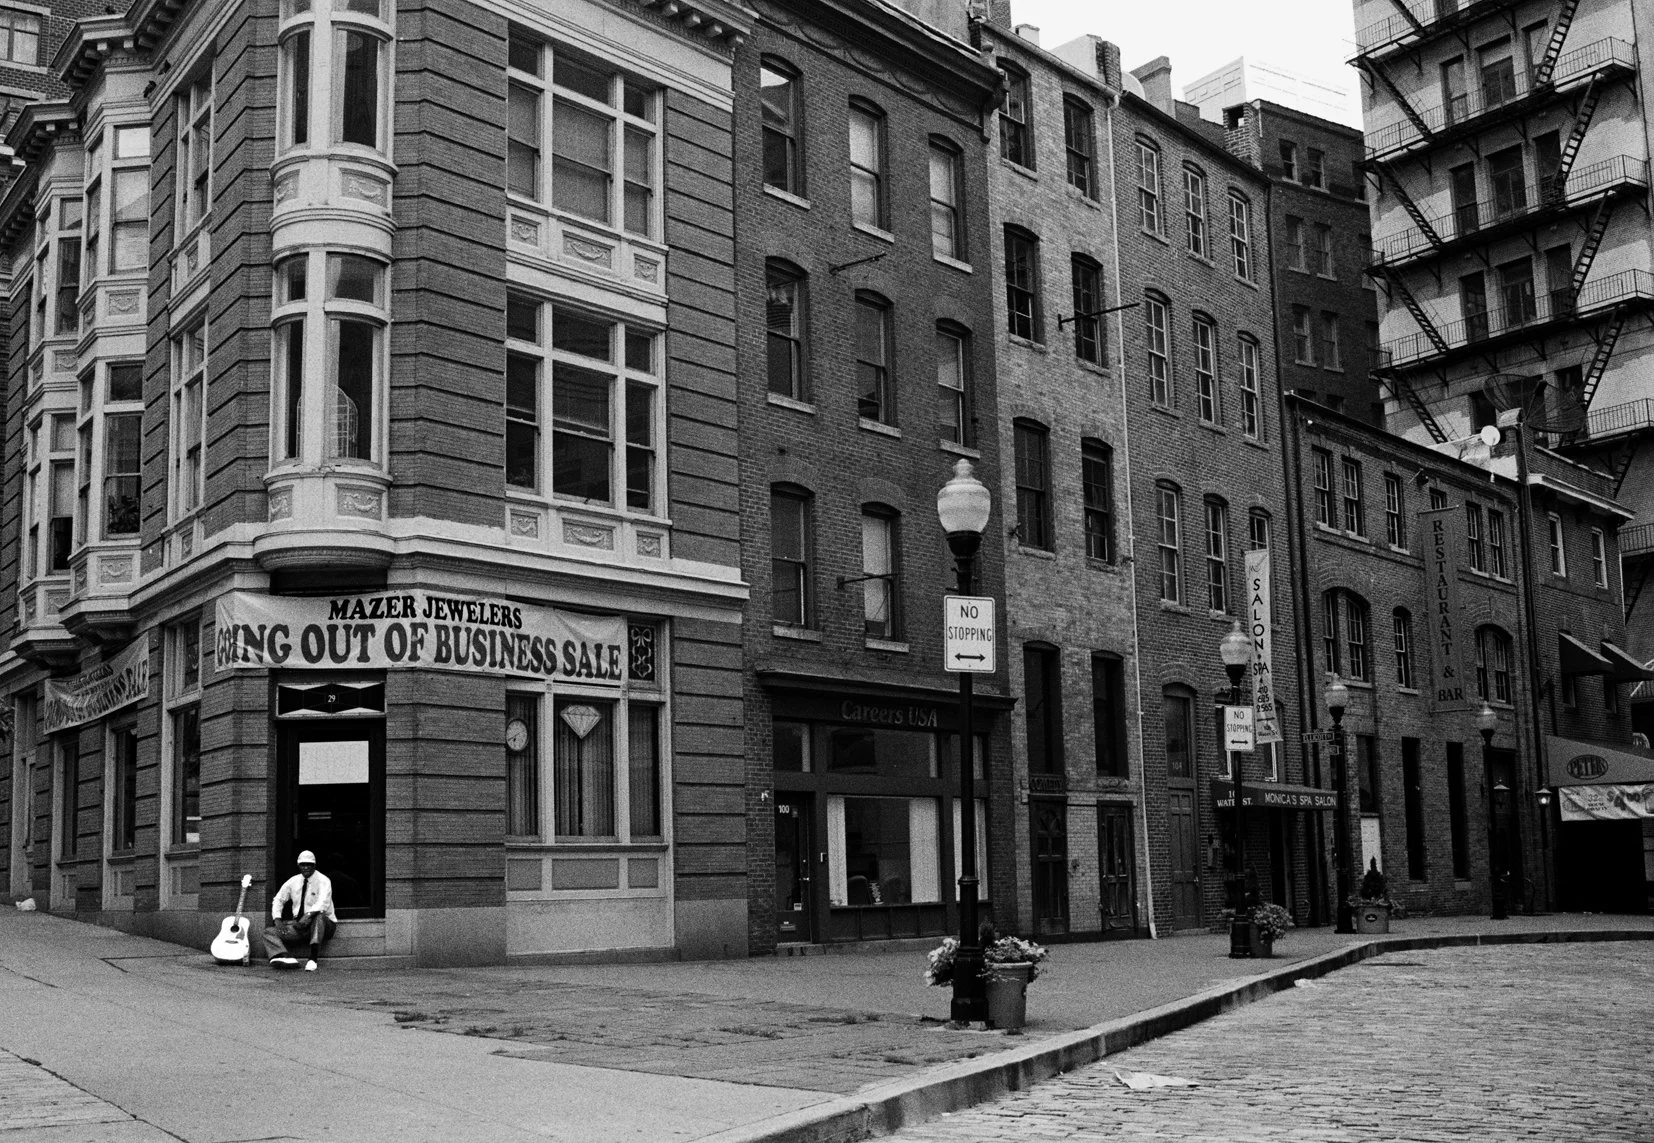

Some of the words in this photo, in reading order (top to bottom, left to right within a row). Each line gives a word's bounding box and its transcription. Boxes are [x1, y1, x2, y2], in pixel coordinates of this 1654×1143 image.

[1432, 520, 1453, 656] RESTAURANT
[328, 595, 417, 620] MAZER
[423, 596, 522, 629] JEWELERS
[961, 605, 979, 619] NO
[1251, 578, 1265, 651] SALON
[948, 626, 992, 642] STOPPING
[217, 623, 292, 667] GOING
[300, 623, 376, 664] OUT
[383, 622, 429, 663] OF
[433, 624, 557, 675] BUSINESS
[562, 639, 622, 680] SALE
[1253, 662, 1270, 676] SPA
[1443, 665, 1455, 678] &
[327, 694, 336, 703] 29
[1438, 687, 1464, 702] BAR
[841, 700, 904, 724] Careers
[908, 706, 938, 727] USA
[1234, 711, 1244, 719] NO
[1256, 703, 1273, 713] 2565
[1226, 723, 1253, 733] STOPPING
[1217, 798, 1236, 807] WATE
[1264, 792, 1297, 805] MONICA'S
[1299, 795, 1313, 805] SPA
[1315, 796, 1337, 806] SALON
[778, 804, 790, 814] 100
